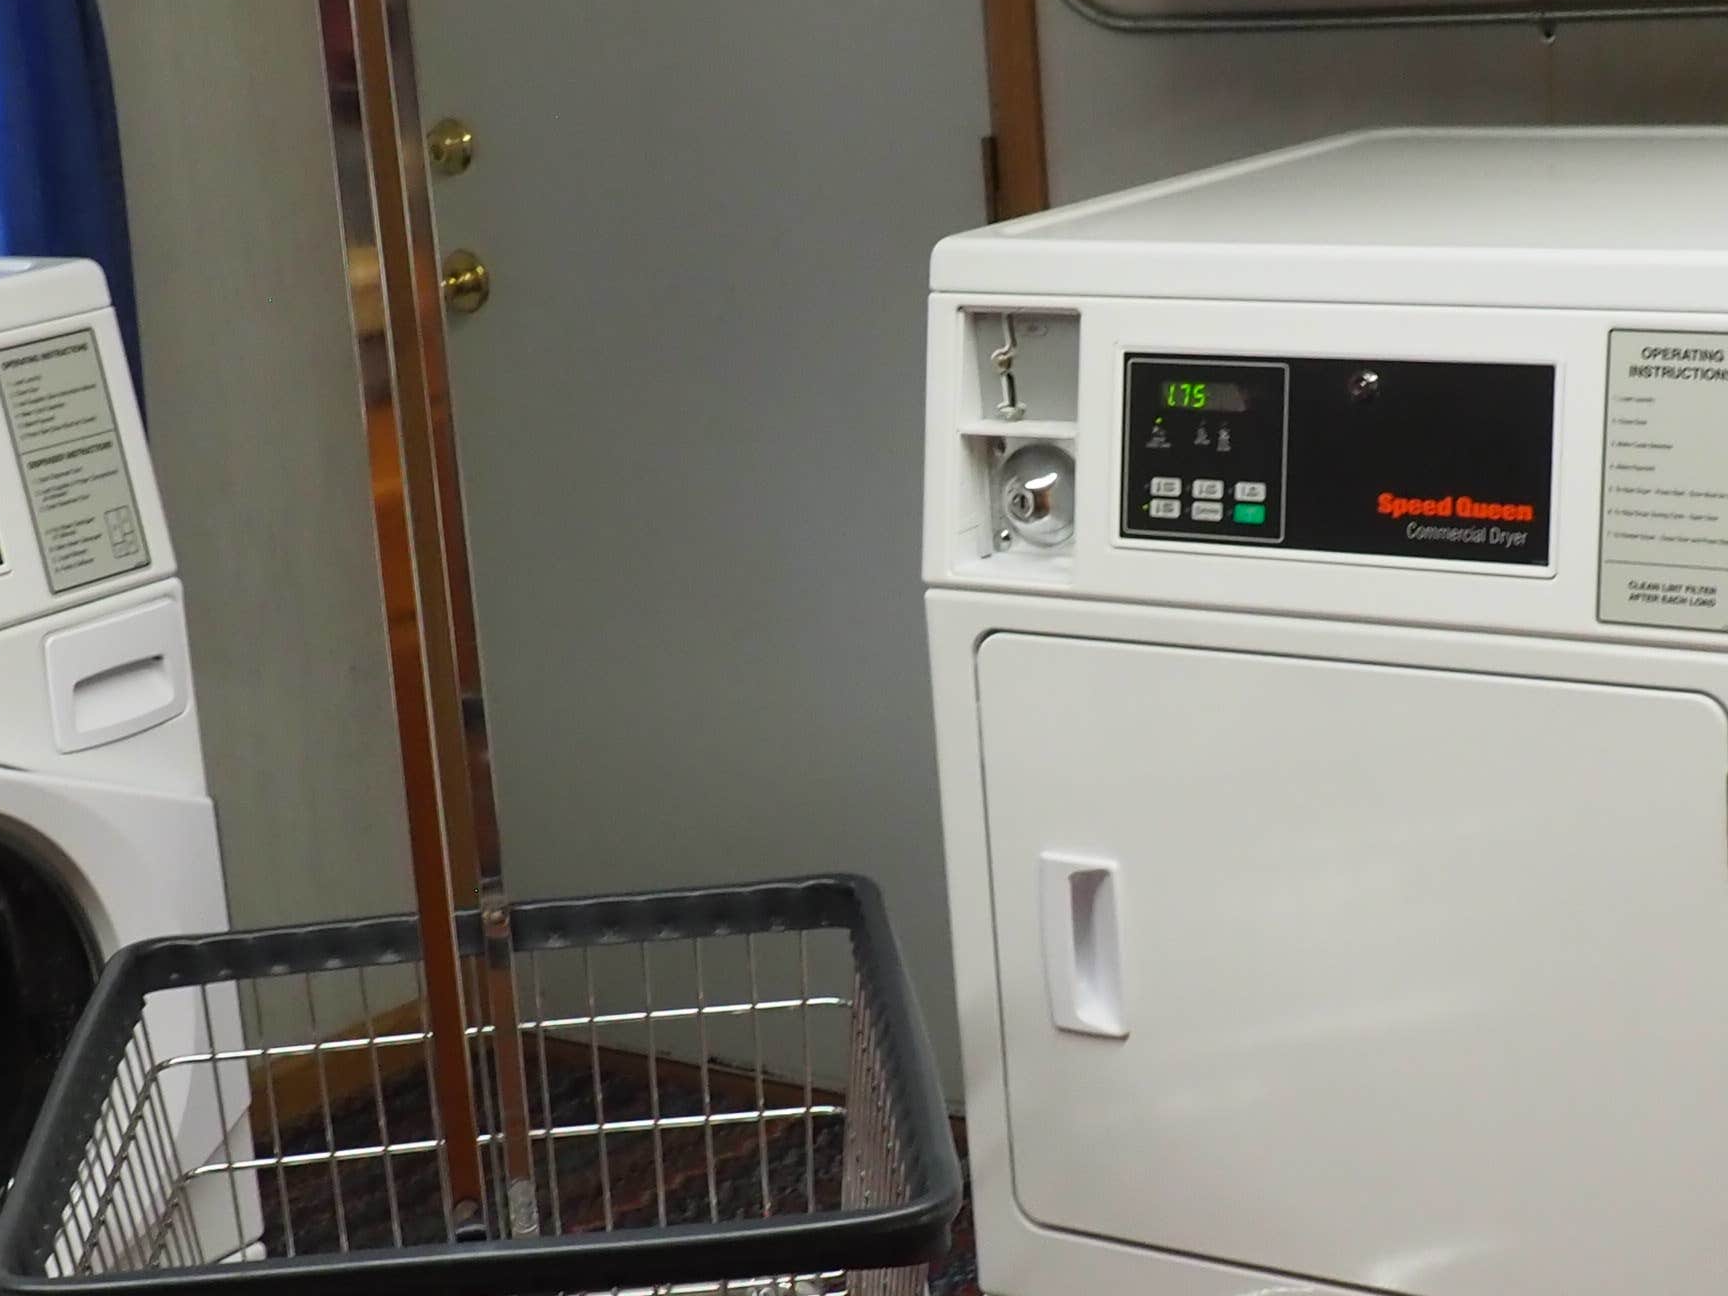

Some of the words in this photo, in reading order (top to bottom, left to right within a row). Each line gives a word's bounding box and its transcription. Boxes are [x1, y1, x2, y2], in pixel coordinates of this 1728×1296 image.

[1640, 345, 1725, 364] OPERATING
[1377, 492, 1454, 519] Speed
[1456, 495, 1535, 522] Queen
[1405, 521, 1487, 544] Commercial
[1488, 526, 1529, 549] Dryer
